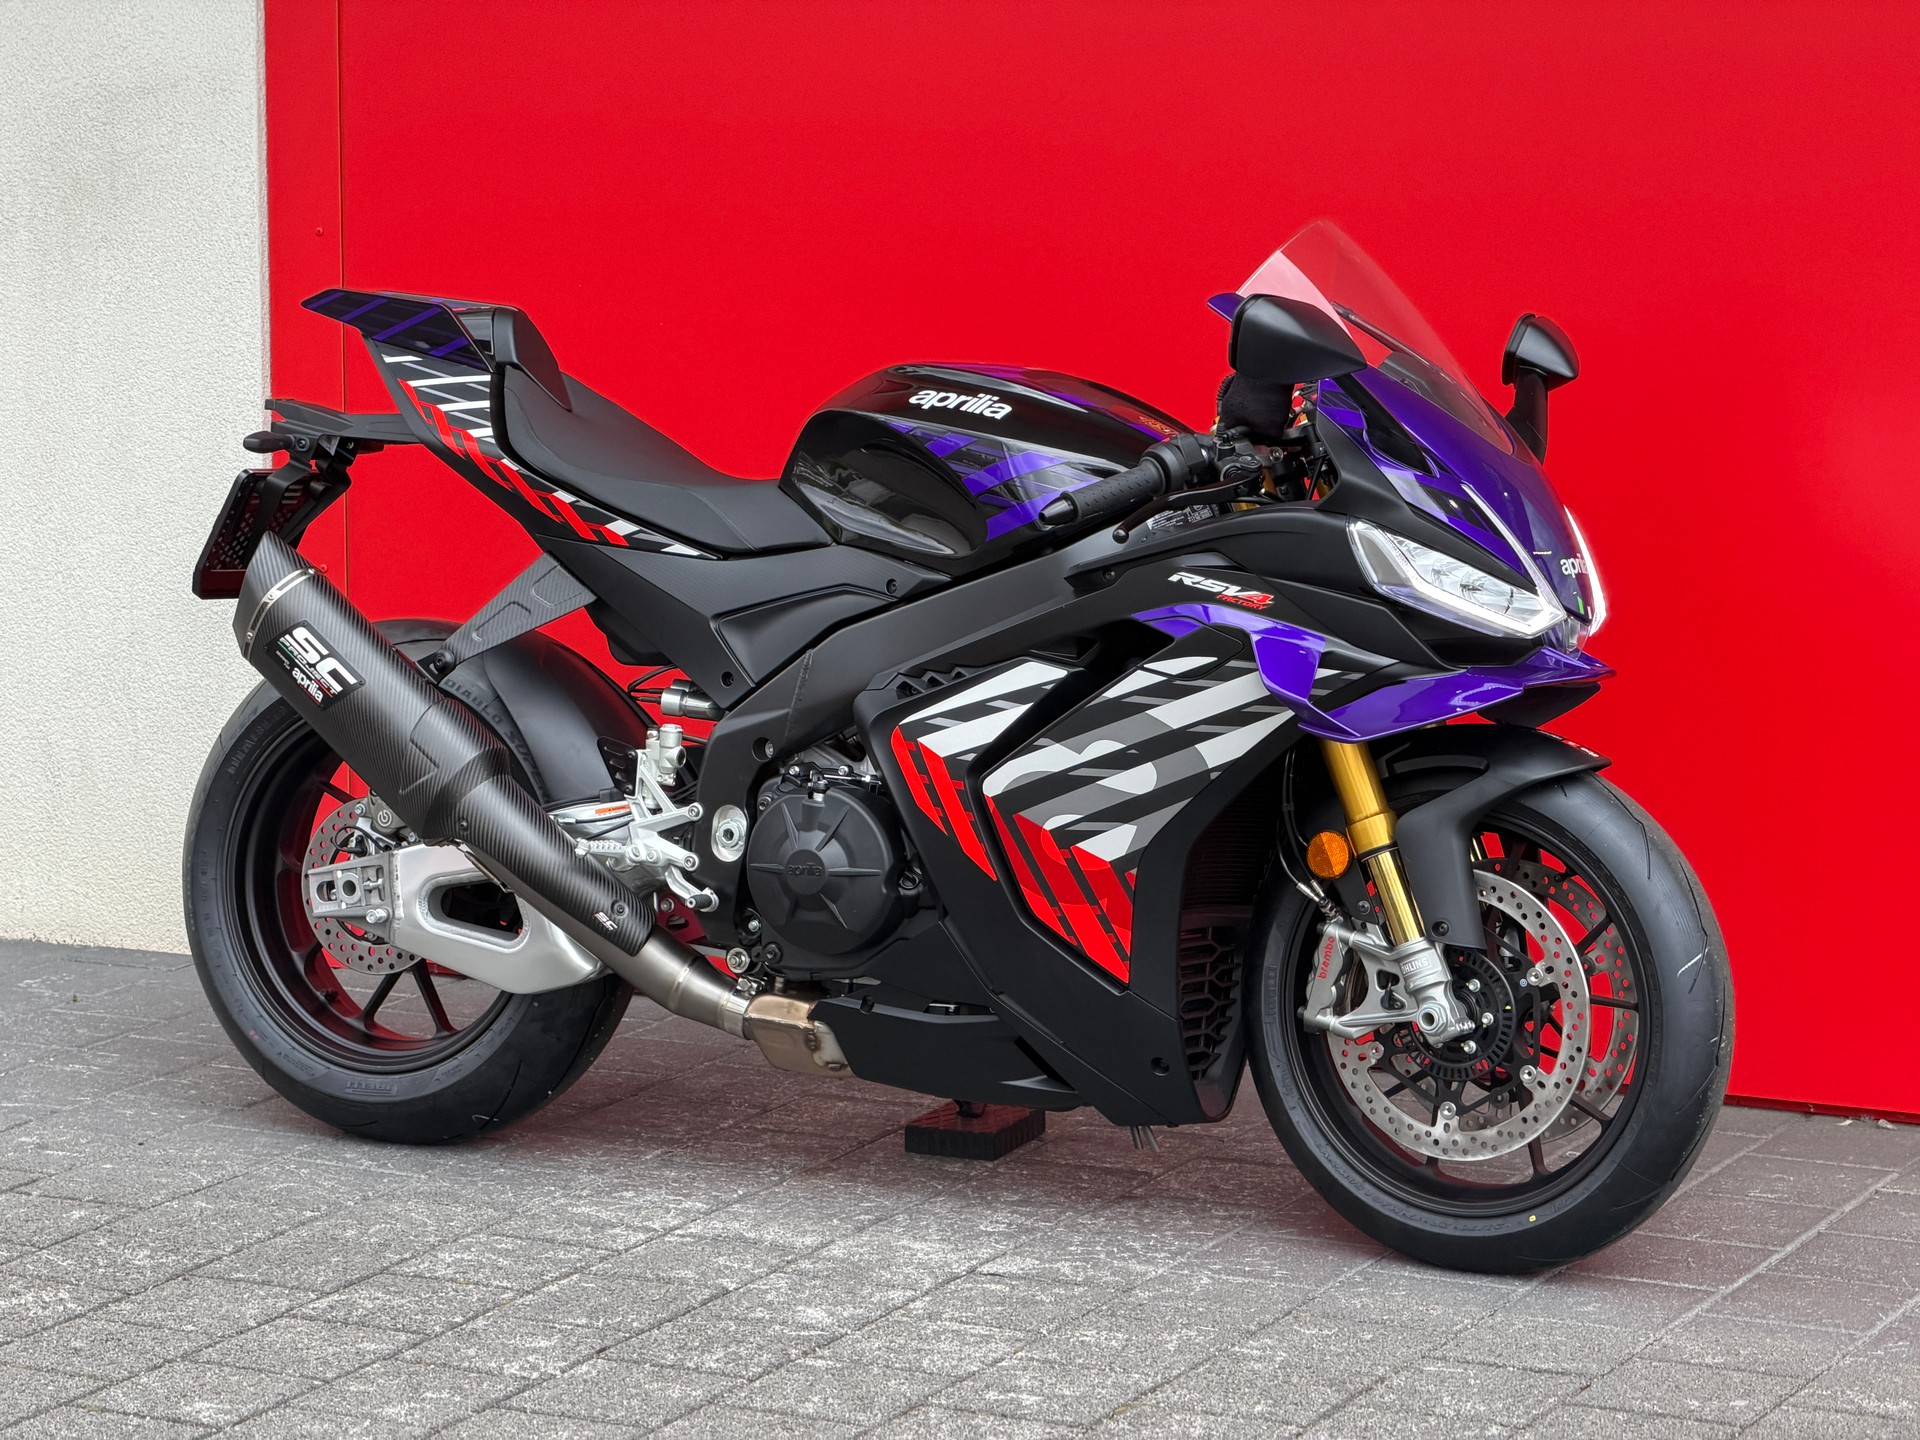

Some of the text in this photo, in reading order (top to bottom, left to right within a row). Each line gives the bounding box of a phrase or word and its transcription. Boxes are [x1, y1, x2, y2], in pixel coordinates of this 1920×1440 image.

[908, 389, 1013, 420] aprilia
[1167, 571, 1274, 605] RSV4
[1216, 594, 1269, 611] FACTORY
[279, 636, 338, 694] PROJECT
[283, 626, 358, 693] SC
[292, 667, 323, 703] aprilia
[444, 679, 502, 723] DIABLO
[788, 862, 823, 877] aprilia
[1317, 936, 1335, 980] brembo
